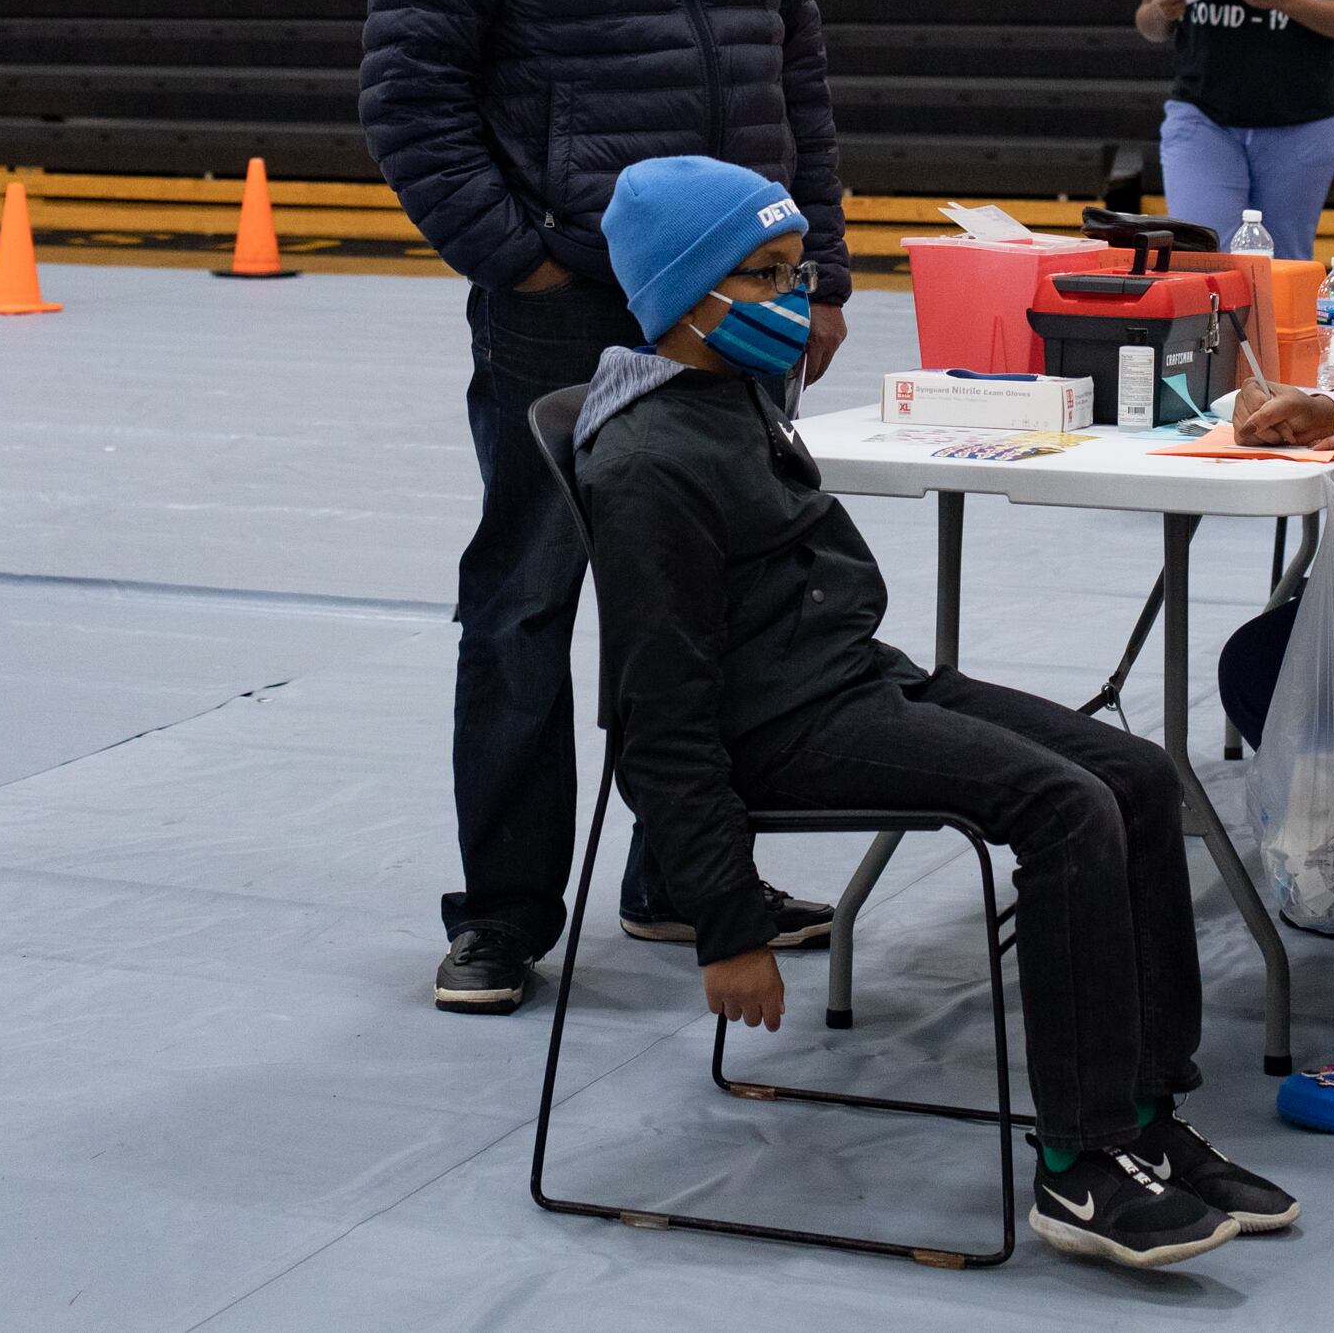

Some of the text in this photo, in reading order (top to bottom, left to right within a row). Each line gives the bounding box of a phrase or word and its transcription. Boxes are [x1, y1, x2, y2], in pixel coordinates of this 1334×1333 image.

[1166, 351, 1194, 366] CRAFTSMAN
[952, 386, 982, 396] Nitrile
[983, 388, 1004, 396] Exam
[1006, 390, 1031, 398] Gloves
[899, 403, 911, 412] XL
